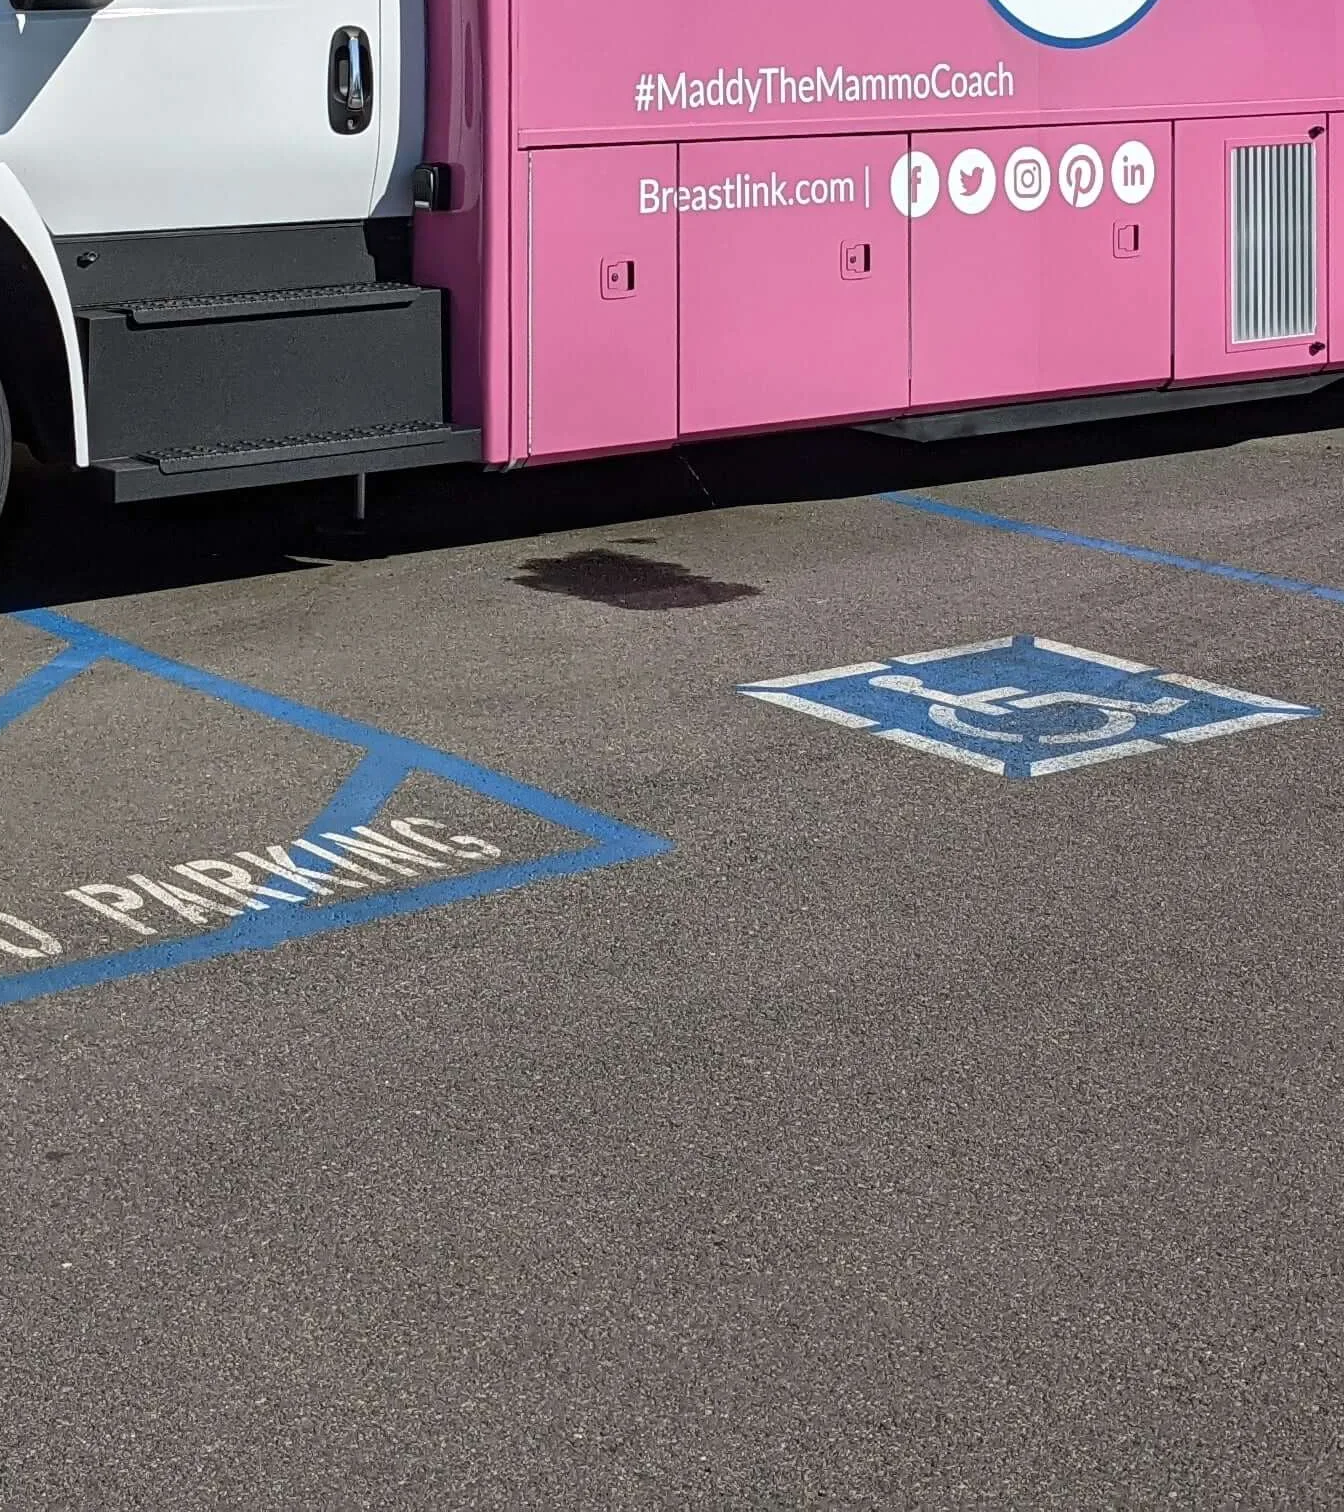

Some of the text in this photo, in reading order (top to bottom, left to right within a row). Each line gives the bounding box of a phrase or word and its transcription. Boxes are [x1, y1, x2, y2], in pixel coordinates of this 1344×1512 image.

[634, 61, 1015, 113] #MaddyTheMammoCoach
[639, 172, 855, 214] Breastlink.com
[63, 816, 502, 935] PARKING
